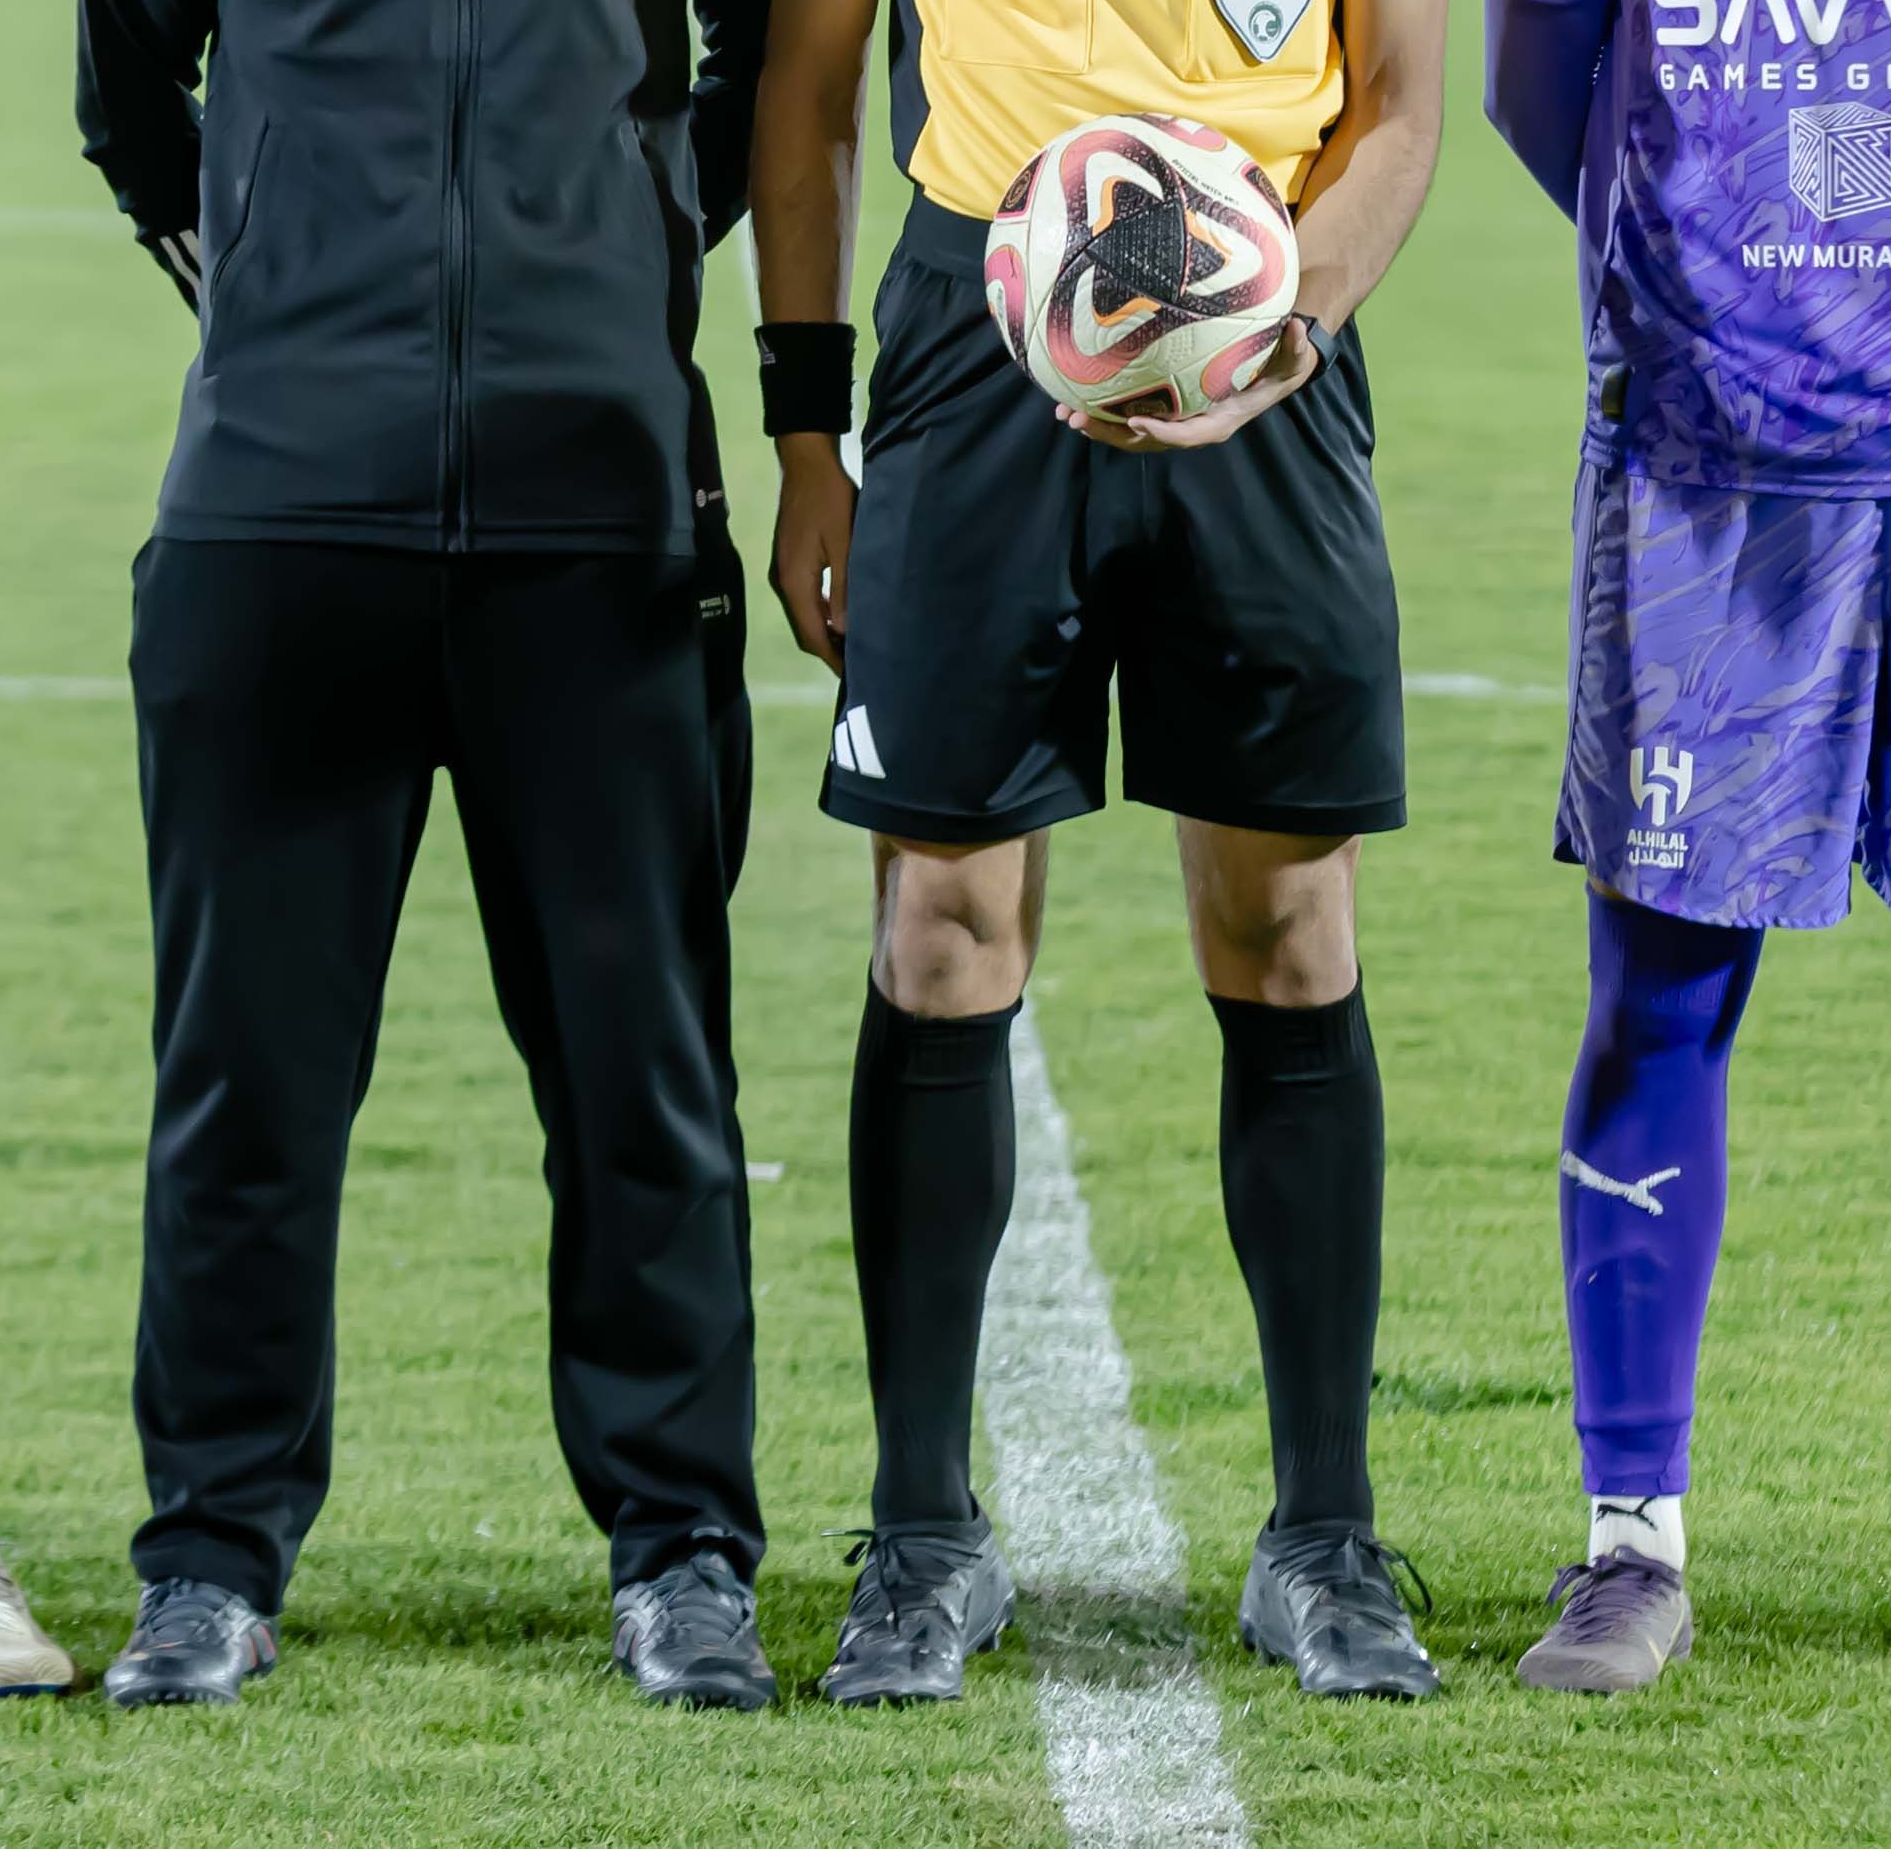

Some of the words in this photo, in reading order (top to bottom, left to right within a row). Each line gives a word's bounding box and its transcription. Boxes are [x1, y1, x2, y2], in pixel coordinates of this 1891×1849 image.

[1659, 62, 1818, 90] GAMES
[1741, 244, 1805, 268] NEW
[1627, 829, 1689, 851] ALHILAL
[1628, 847, 1685, 869] الهلال
